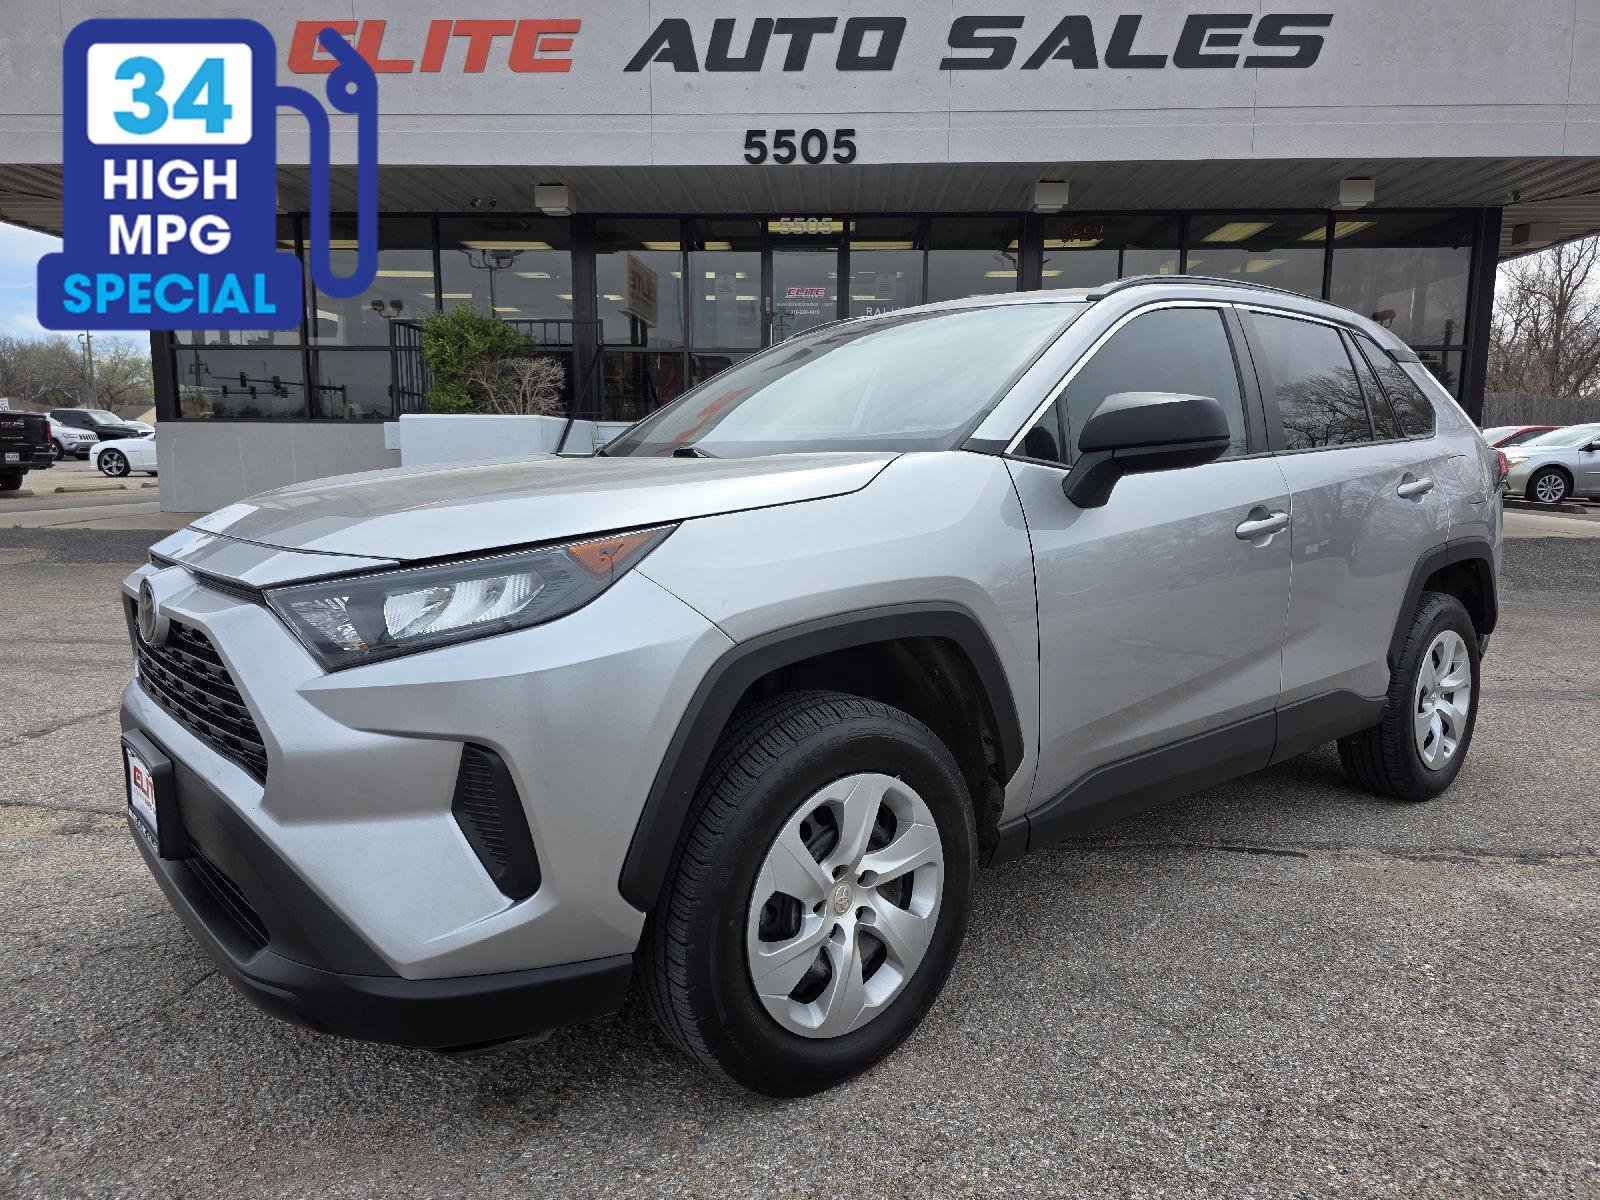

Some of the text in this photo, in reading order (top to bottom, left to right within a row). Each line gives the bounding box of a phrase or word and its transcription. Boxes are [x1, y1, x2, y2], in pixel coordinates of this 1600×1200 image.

[288, 14, 1334, 73] ELITE AUTO SALES
[743, 128, 857, 165] 5505
[780, 217, 833, 235] 5505
[786, 287, 825, 296] ELITE
